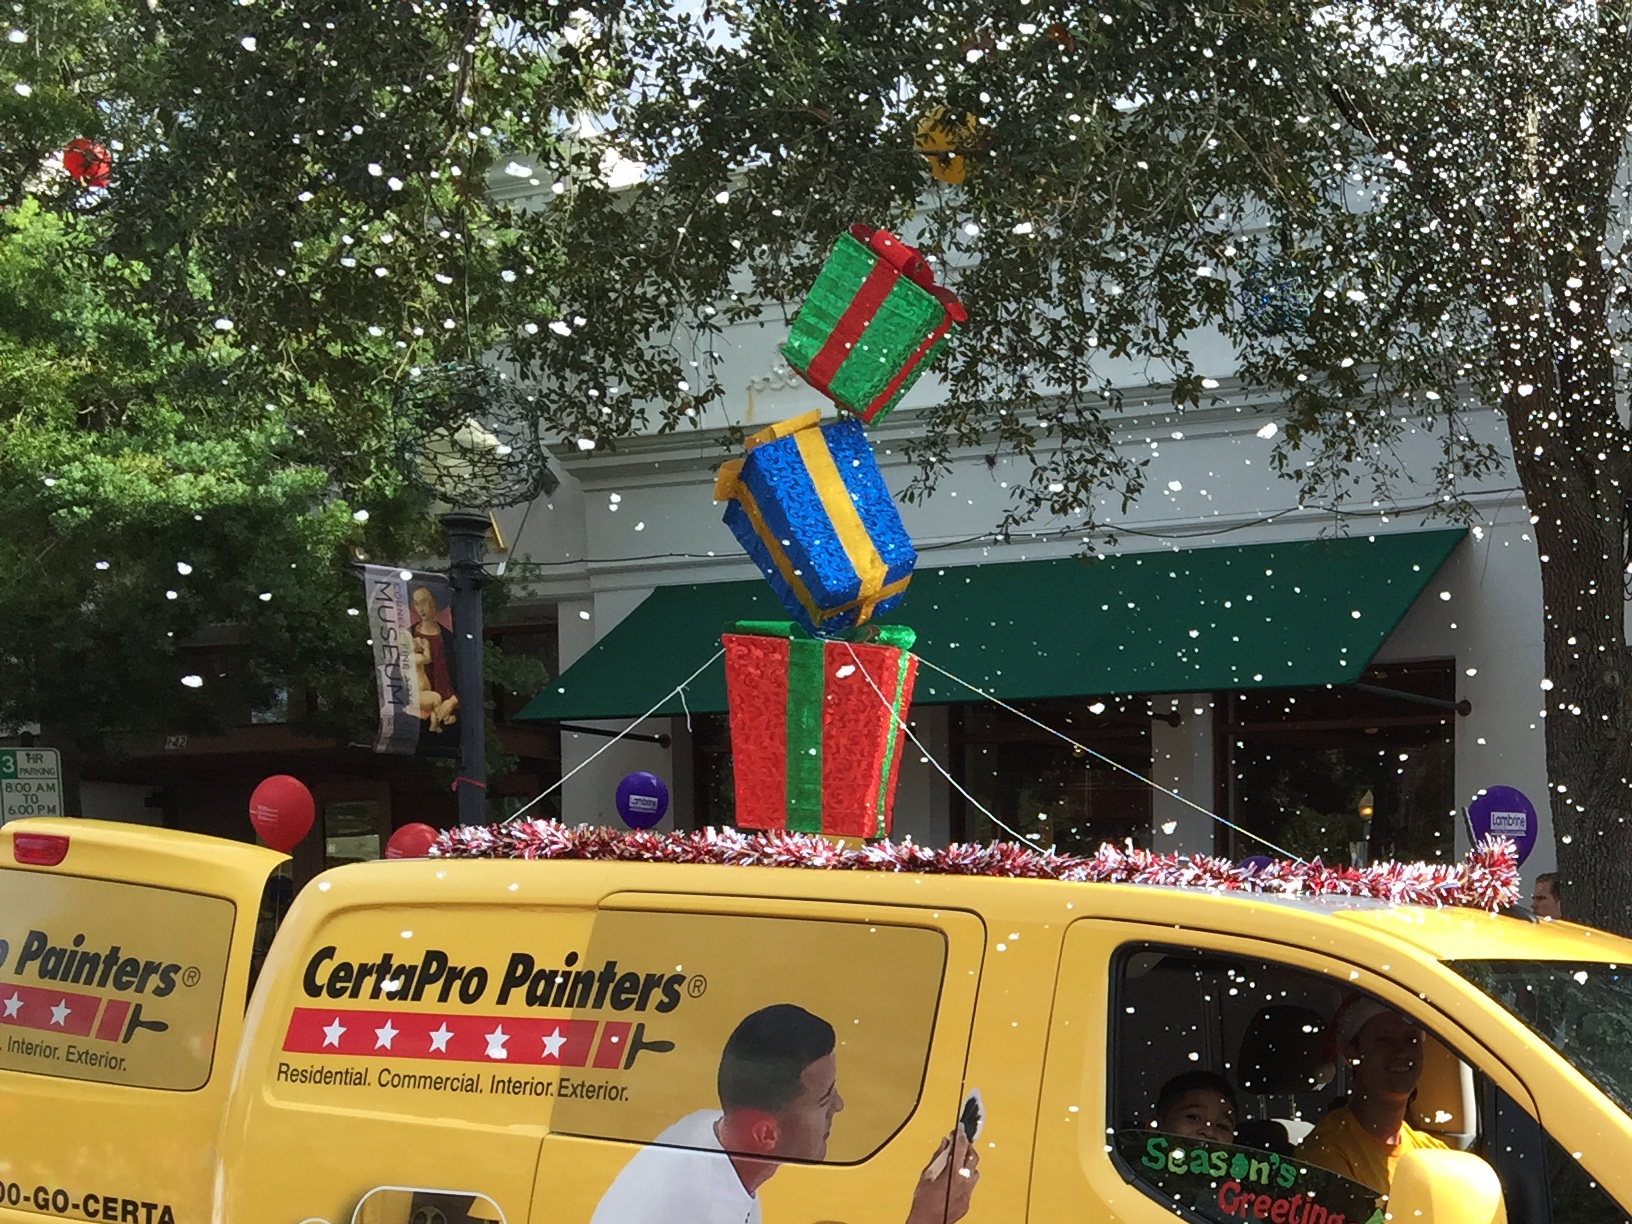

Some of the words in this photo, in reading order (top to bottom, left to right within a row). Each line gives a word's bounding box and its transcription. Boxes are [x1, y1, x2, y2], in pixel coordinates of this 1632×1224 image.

[374, 580, 404, 705] MUSEUM
[2, 755, 15, 773] 3
[27, 753, 43, 763] HR
[20, 767, 55, 776] PARKING
[22, 794, 39, 804] TO
[36, 783, 56, 793] AM
[37, 805, 56, 815] PM
[303, 946, 488, 1005] CertaPro
[7, 1035, 60, 1061] Interior.
[65, 1044, 127, 1071] Exterior.
[276, 1062, 371, 1087] Residential.
[378, 1067, 483, 1094] Commercial.
[489, 1074, 554, 1097] Interior.
[558, 1078, 629, 1101] Exterior.
[1141, 1137, 1296, 1188] Season's
